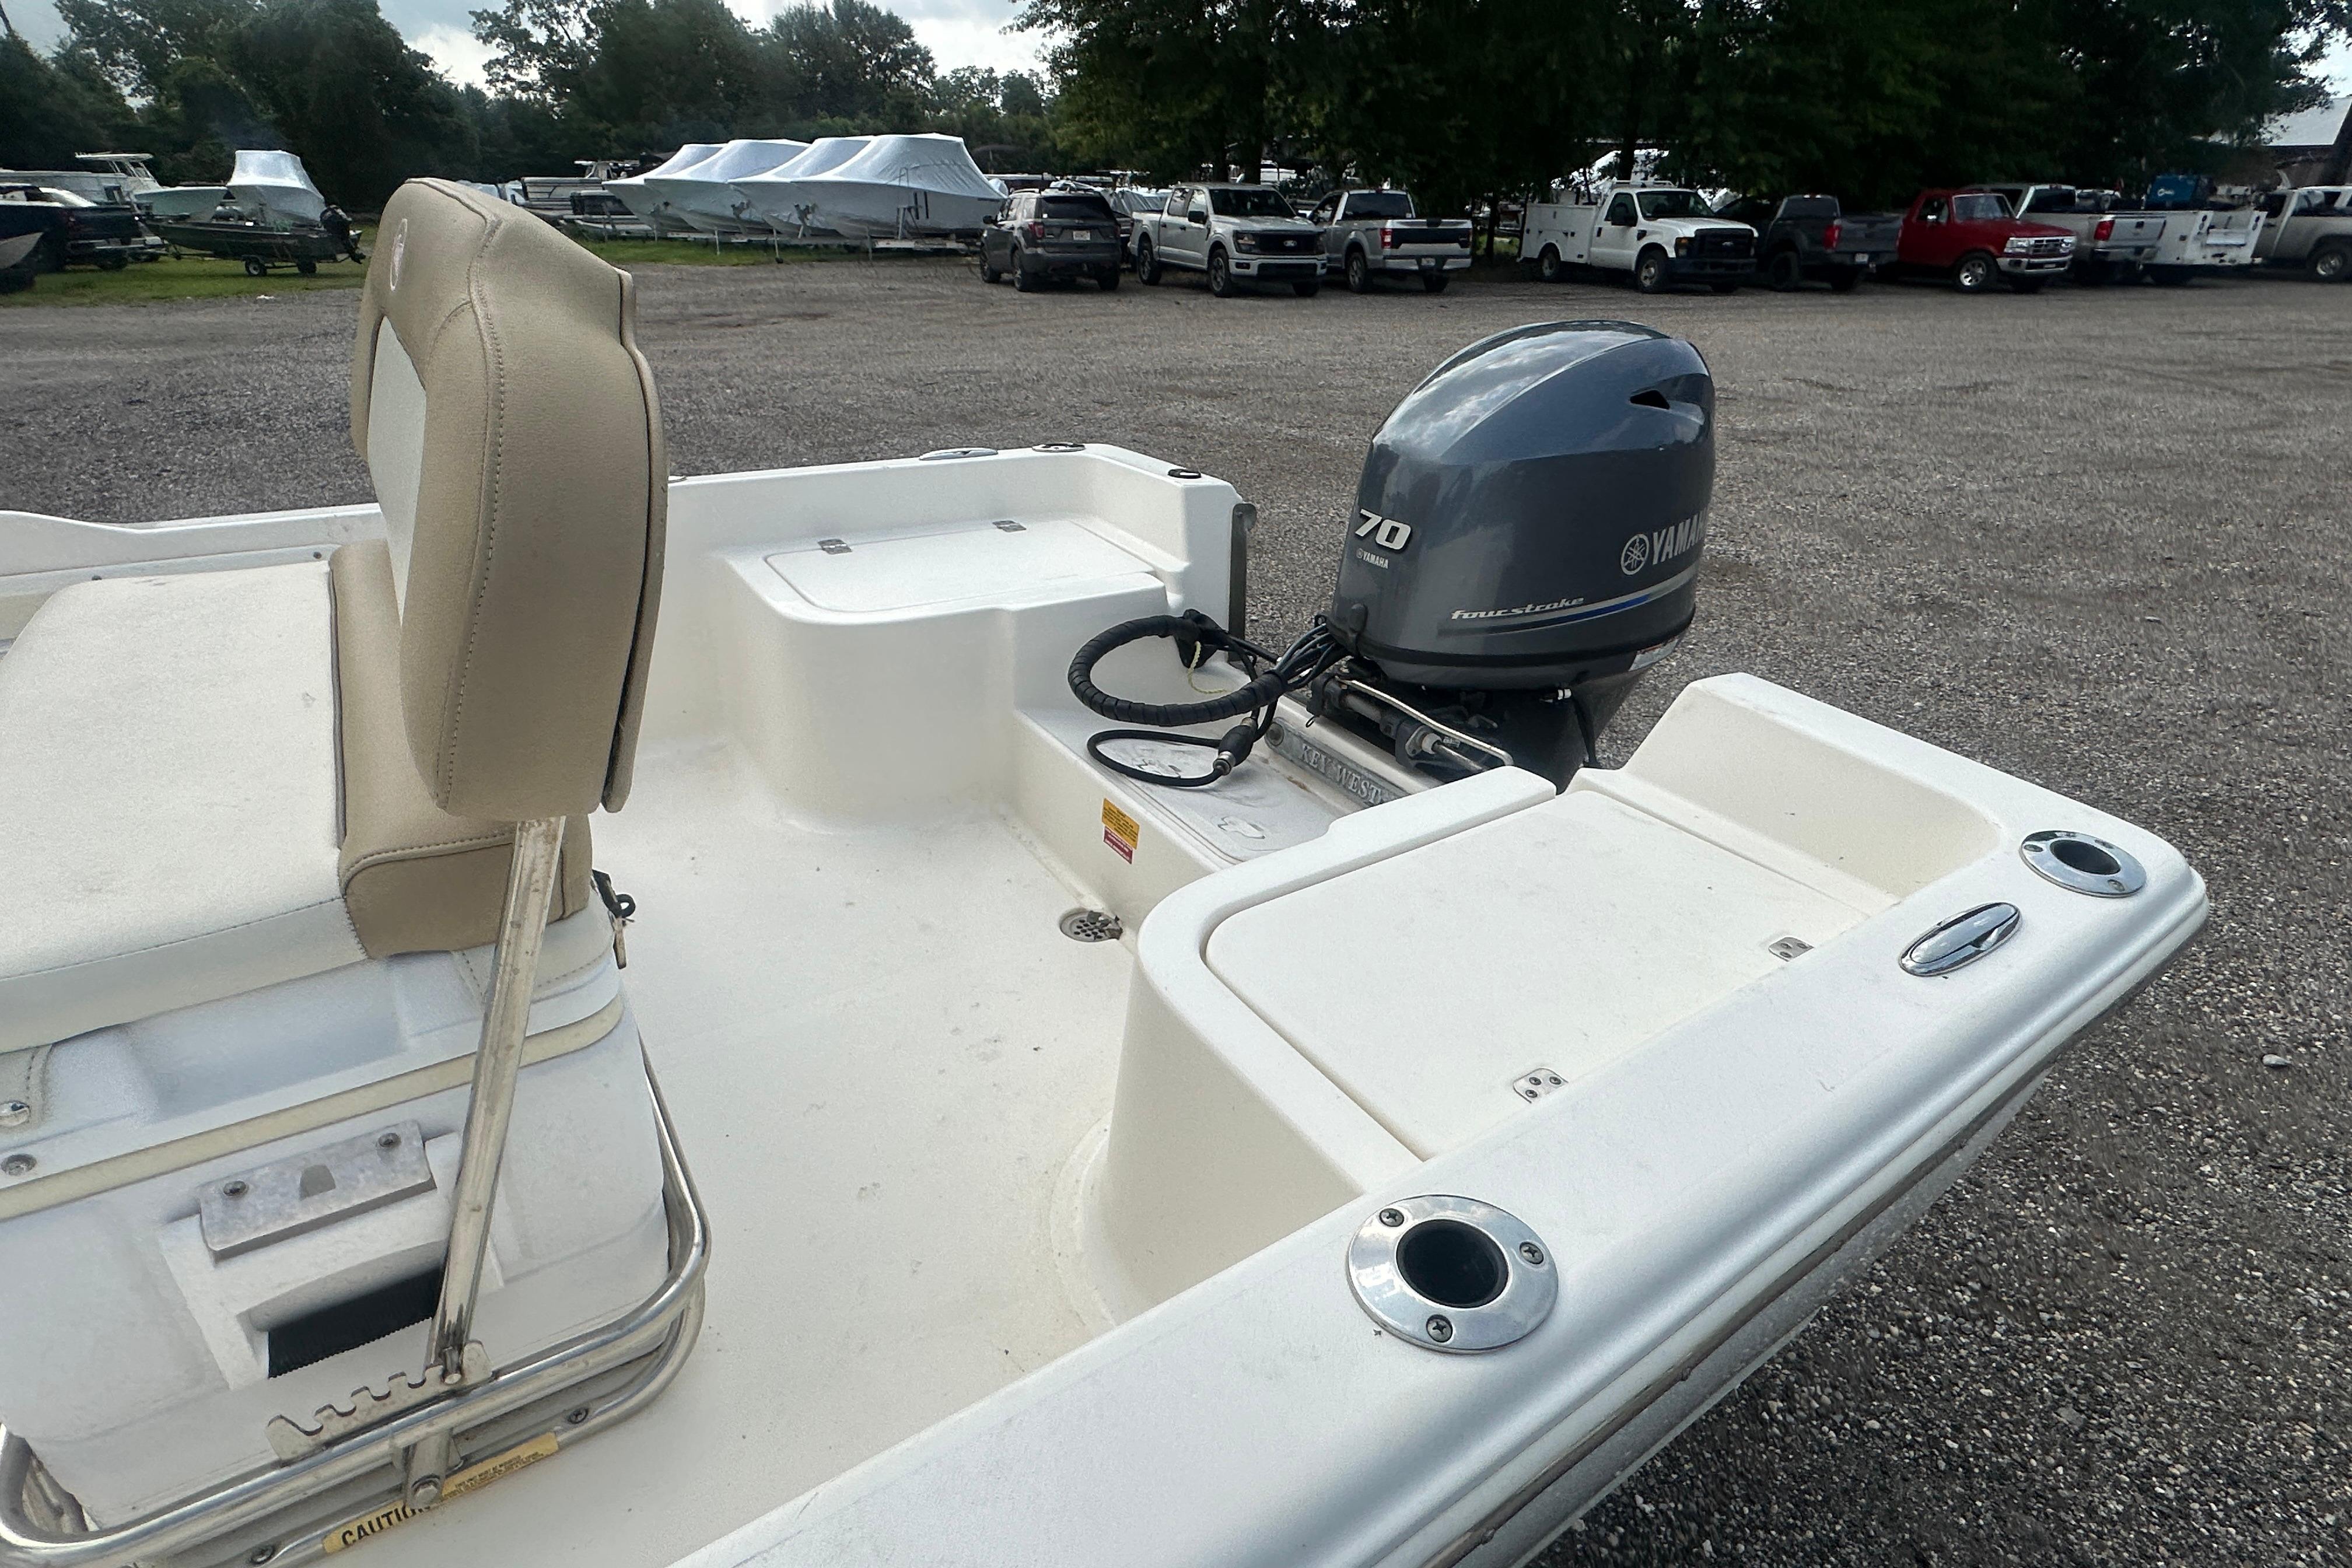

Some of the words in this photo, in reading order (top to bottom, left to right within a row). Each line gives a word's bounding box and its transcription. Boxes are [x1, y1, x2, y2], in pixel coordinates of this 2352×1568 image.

[1355, 509, 1411, 550] 70
[1652, 507, 1708, 565] YAMAH
[1363, 551, 1388, 569] YAMAHA
[1299, 743, 1327, 773] KEY
[1336, 765, 1382, 804] WEST
[342, 1503, 430, 1546] CAUTIO
